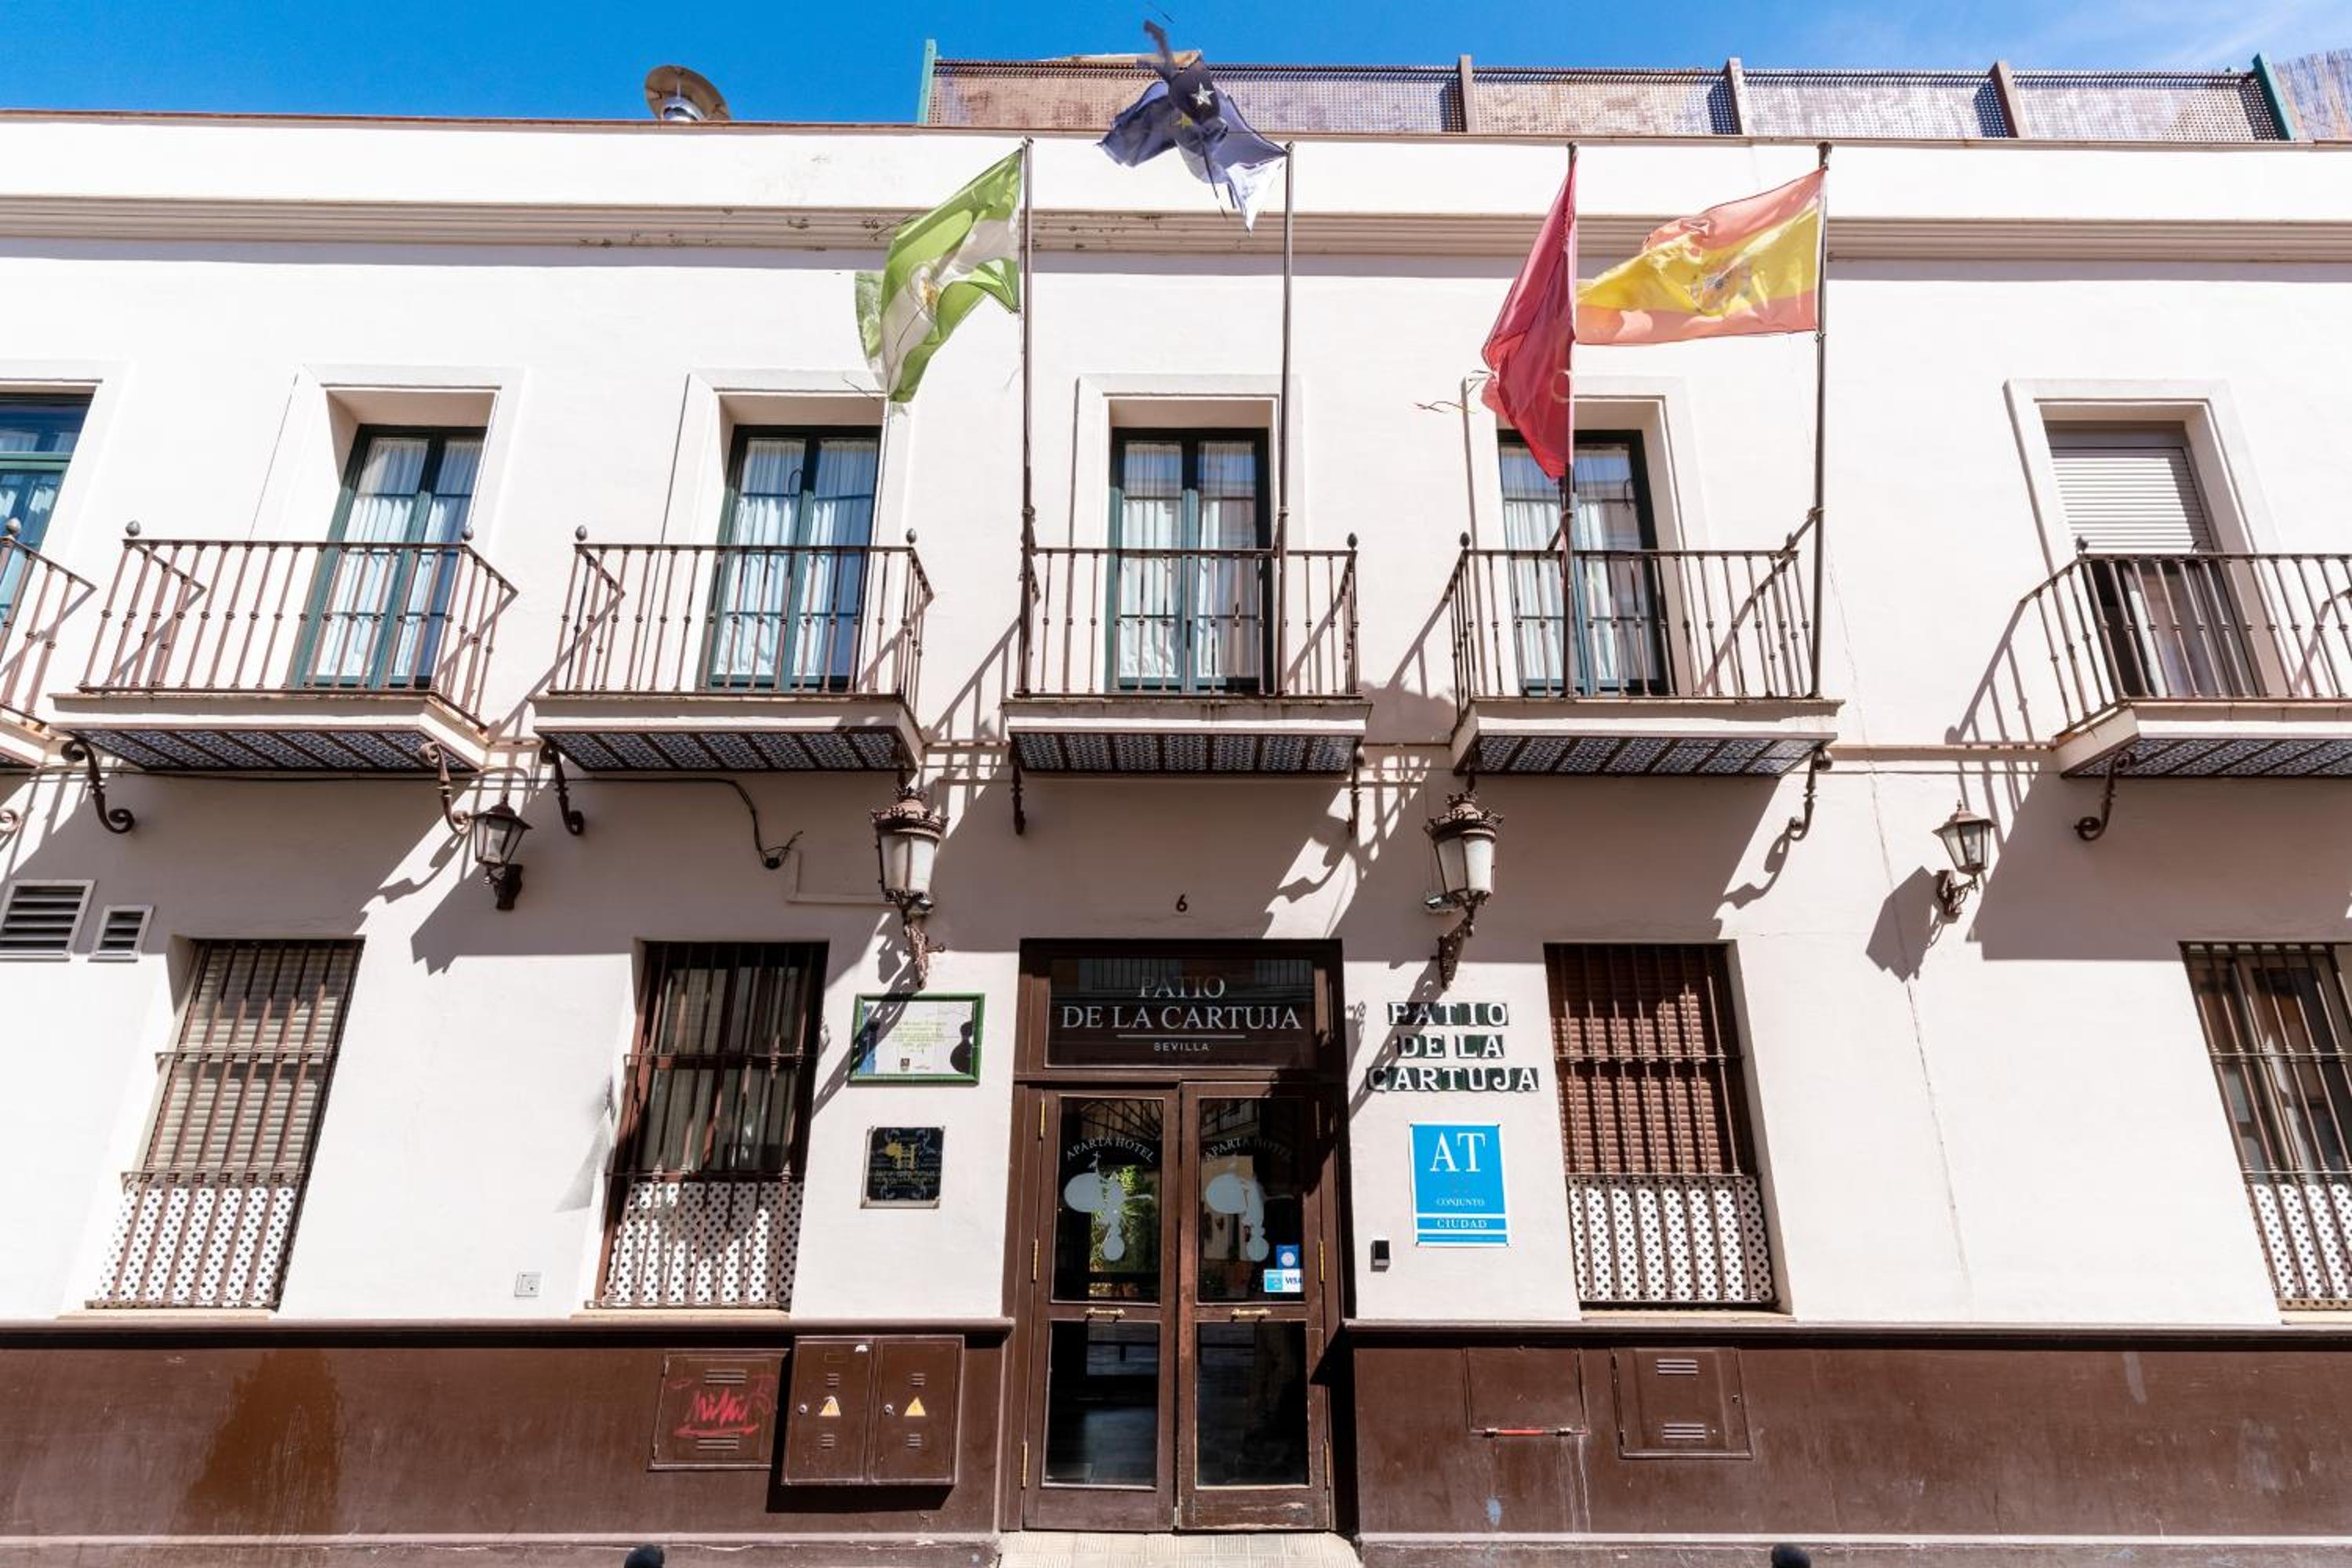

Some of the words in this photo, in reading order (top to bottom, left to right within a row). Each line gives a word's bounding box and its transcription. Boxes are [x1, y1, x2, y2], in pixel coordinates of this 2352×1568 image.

[1176, 894, 1188, 913] 6
[1137, 977, 1225, 998] PATIO
[1062, 1006, 1104, 1029] DE
[1111, 1006, 1154, 1029] LA
[1160, 1006, 1303, 1029] CARTUJA
[1390, 1003, 1508, 1025] PATIO
[1153, 1042, 1210, 1051] SEVILLA
[1399, 1034, 1444, 1058] DE
[1457, 1035, 1503, 1058] LA
[1367, 1067, 1540, 1091] CARTUJA
[1067, 1136, 1112, 1161] APARTA
[1115, 1135, 1154, 1163] HOTEL
[1429, 1131, 1486, 1173] AT
[1436, 1218, 1487, 1229] CIUDAD
